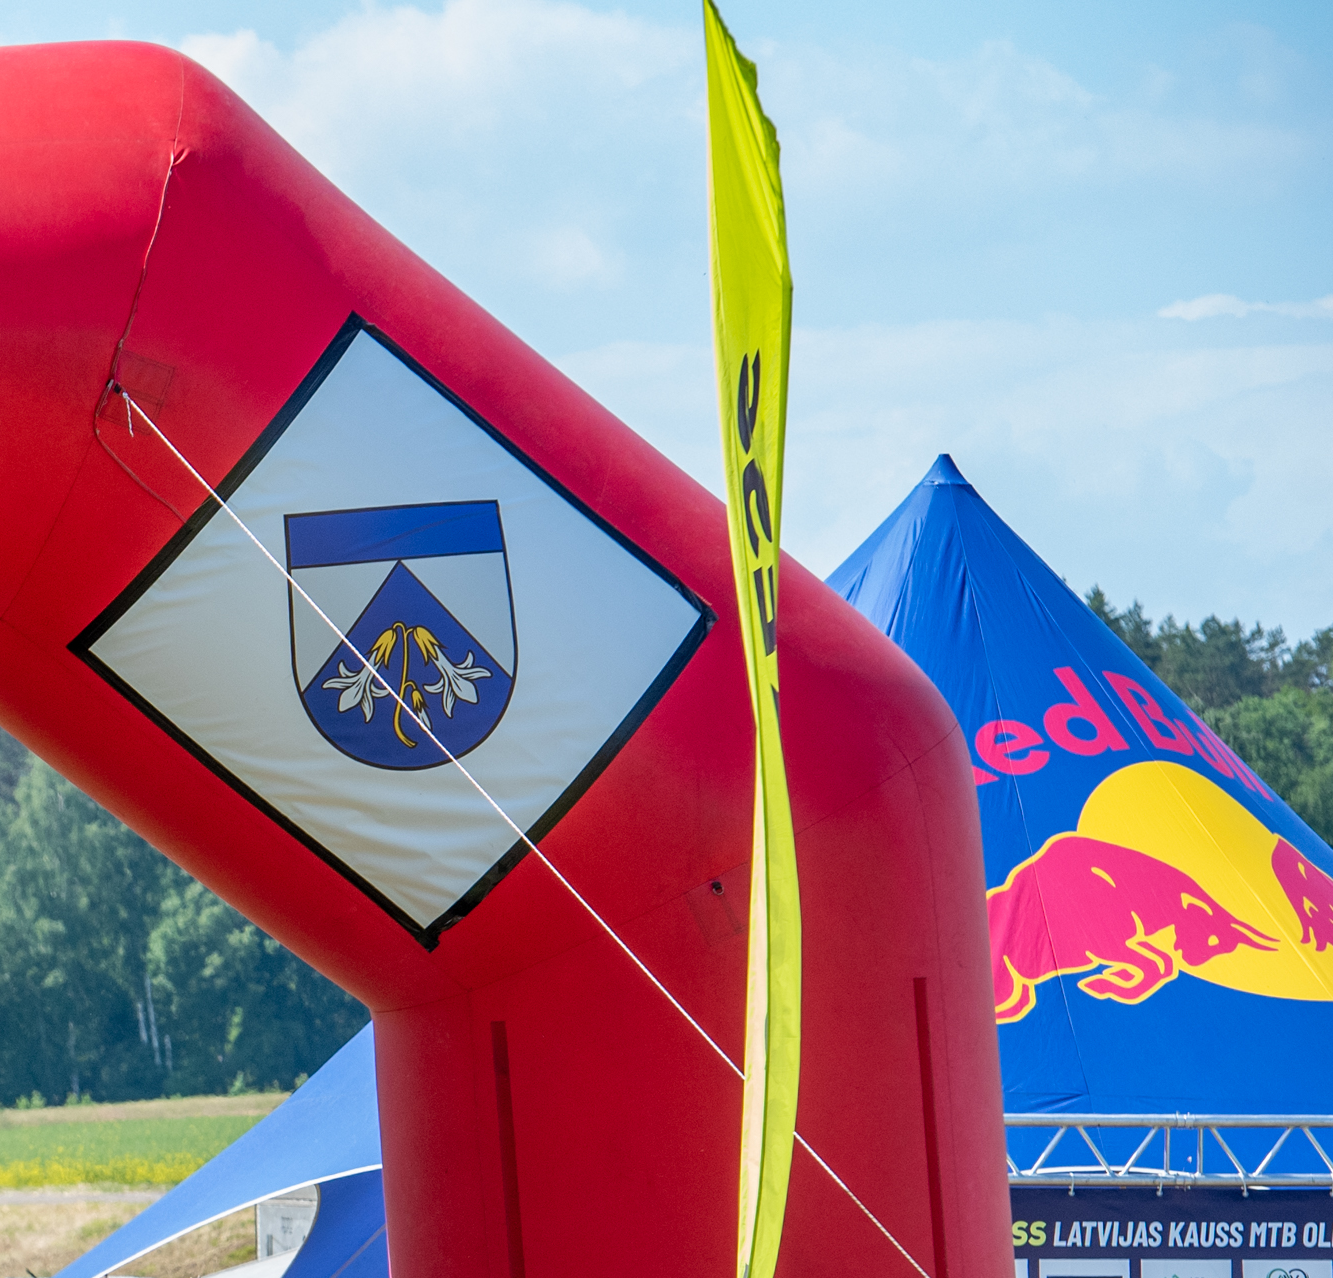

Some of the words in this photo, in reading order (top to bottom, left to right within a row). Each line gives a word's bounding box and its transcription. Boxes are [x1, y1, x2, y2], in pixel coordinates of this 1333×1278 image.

[972, 666, 1130, 787] ed
[1052, 1221, 1164, 1248] LATVIJAS
[1167, 1221, 1245, 1248] KAUSS
[1249, 1222, 1297, 1248] MTB
